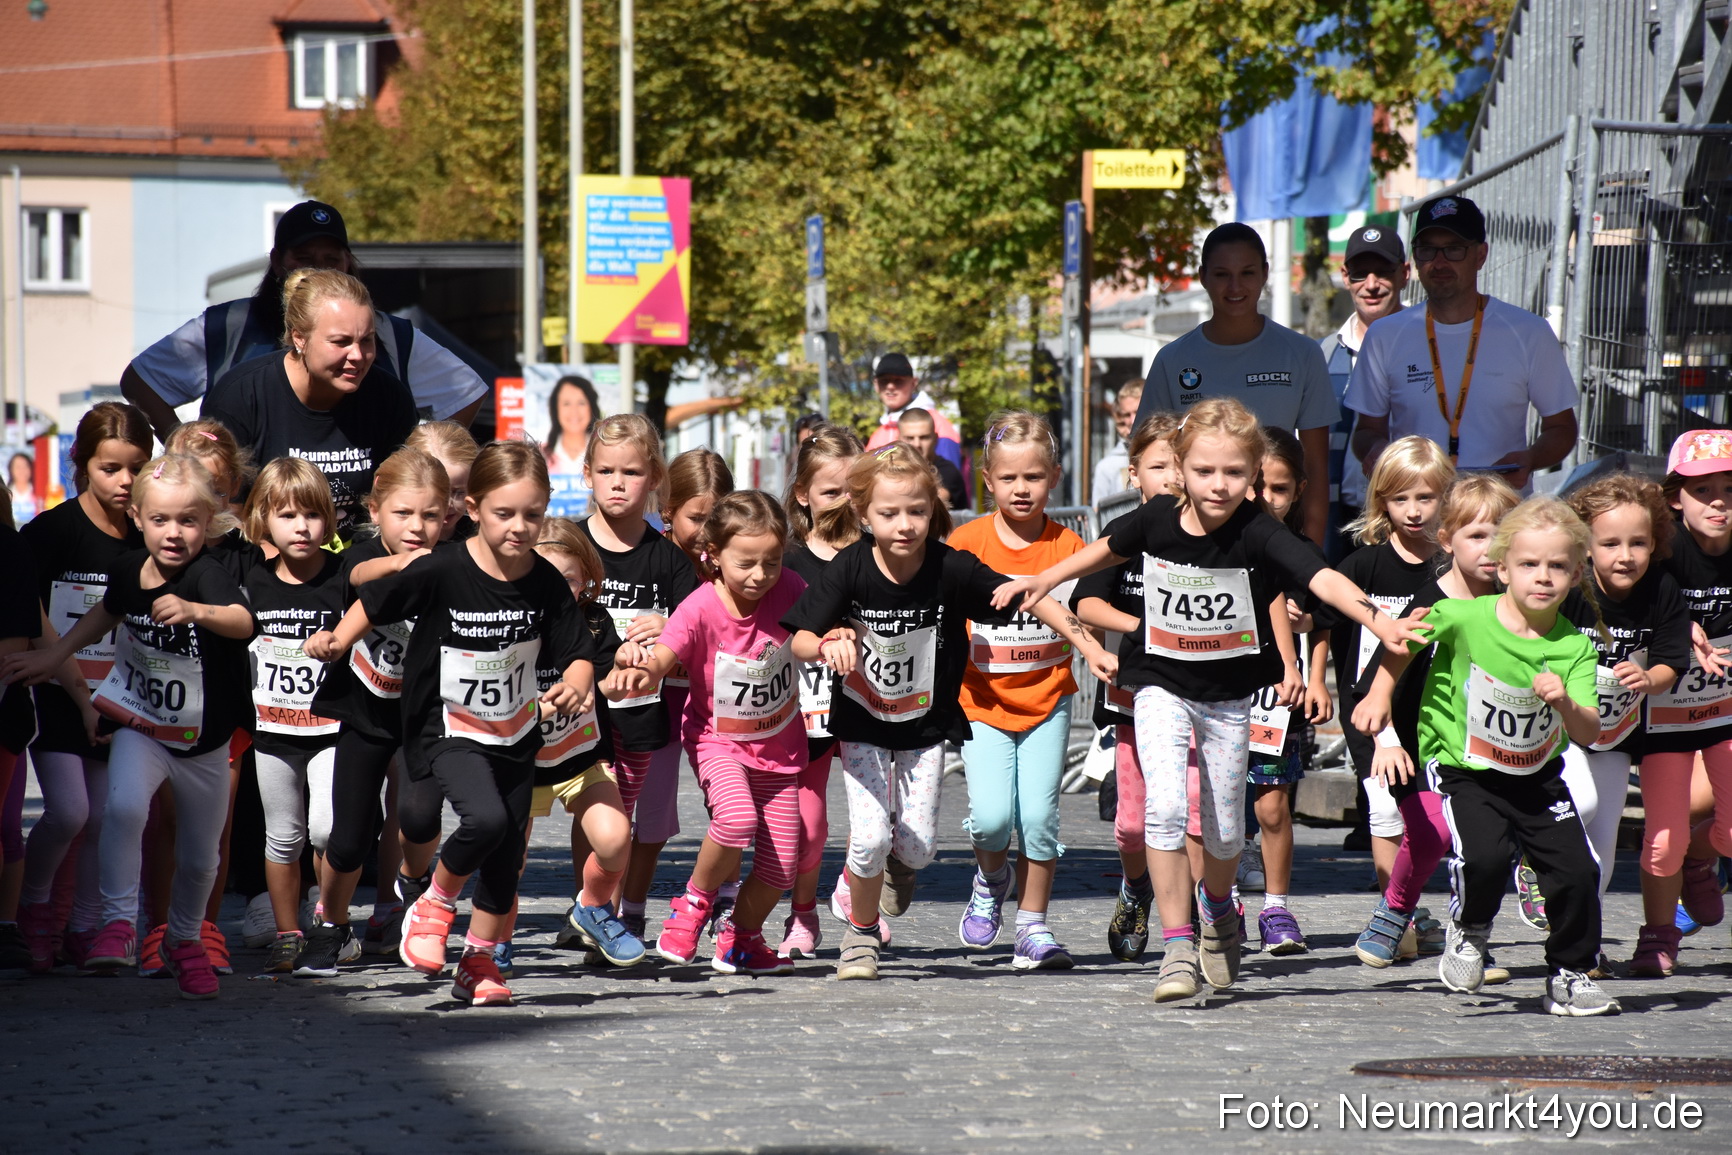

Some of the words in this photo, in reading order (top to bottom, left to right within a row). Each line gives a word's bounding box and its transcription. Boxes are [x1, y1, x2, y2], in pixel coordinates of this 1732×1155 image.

[1095, 161, 1167, 178] Toiletten
[1407, 363, 1419, 373] 16.
[1246, 372, 1291, 383] BOCK
[1180, 393, 1203, 401] PARTL
[1167, 572, 1216, 587] BOCK
[1157, 586, 1237, 622] 7432
[1165, 621, 1187, 632] PARTL
[1018, 634, 1049, 642] Neumarkt
[1177, 636, 1221, 651] Emma
[1010, 648, 1040, 661] Lena
[125, 660, 186, 712] 7360
[459, 661, 526, 707] 7517
[731, 661, 792, 709] 7500
[1672, 697, 1696, 705] PARTL
[267, 706, 320, 727] SARAH
[1481, 698, 1553, 739] 7073
[1687, 705, 1720, 722] Karla
[754, 714, 783, 732] Julia
[1487, 733, 1509, 747] PARTL
[1510, 739, 1543, 749] Neumarkt
[1491, 747, 1547, 768] Mathilda
[1554, 811, 1576, 822] adidas
